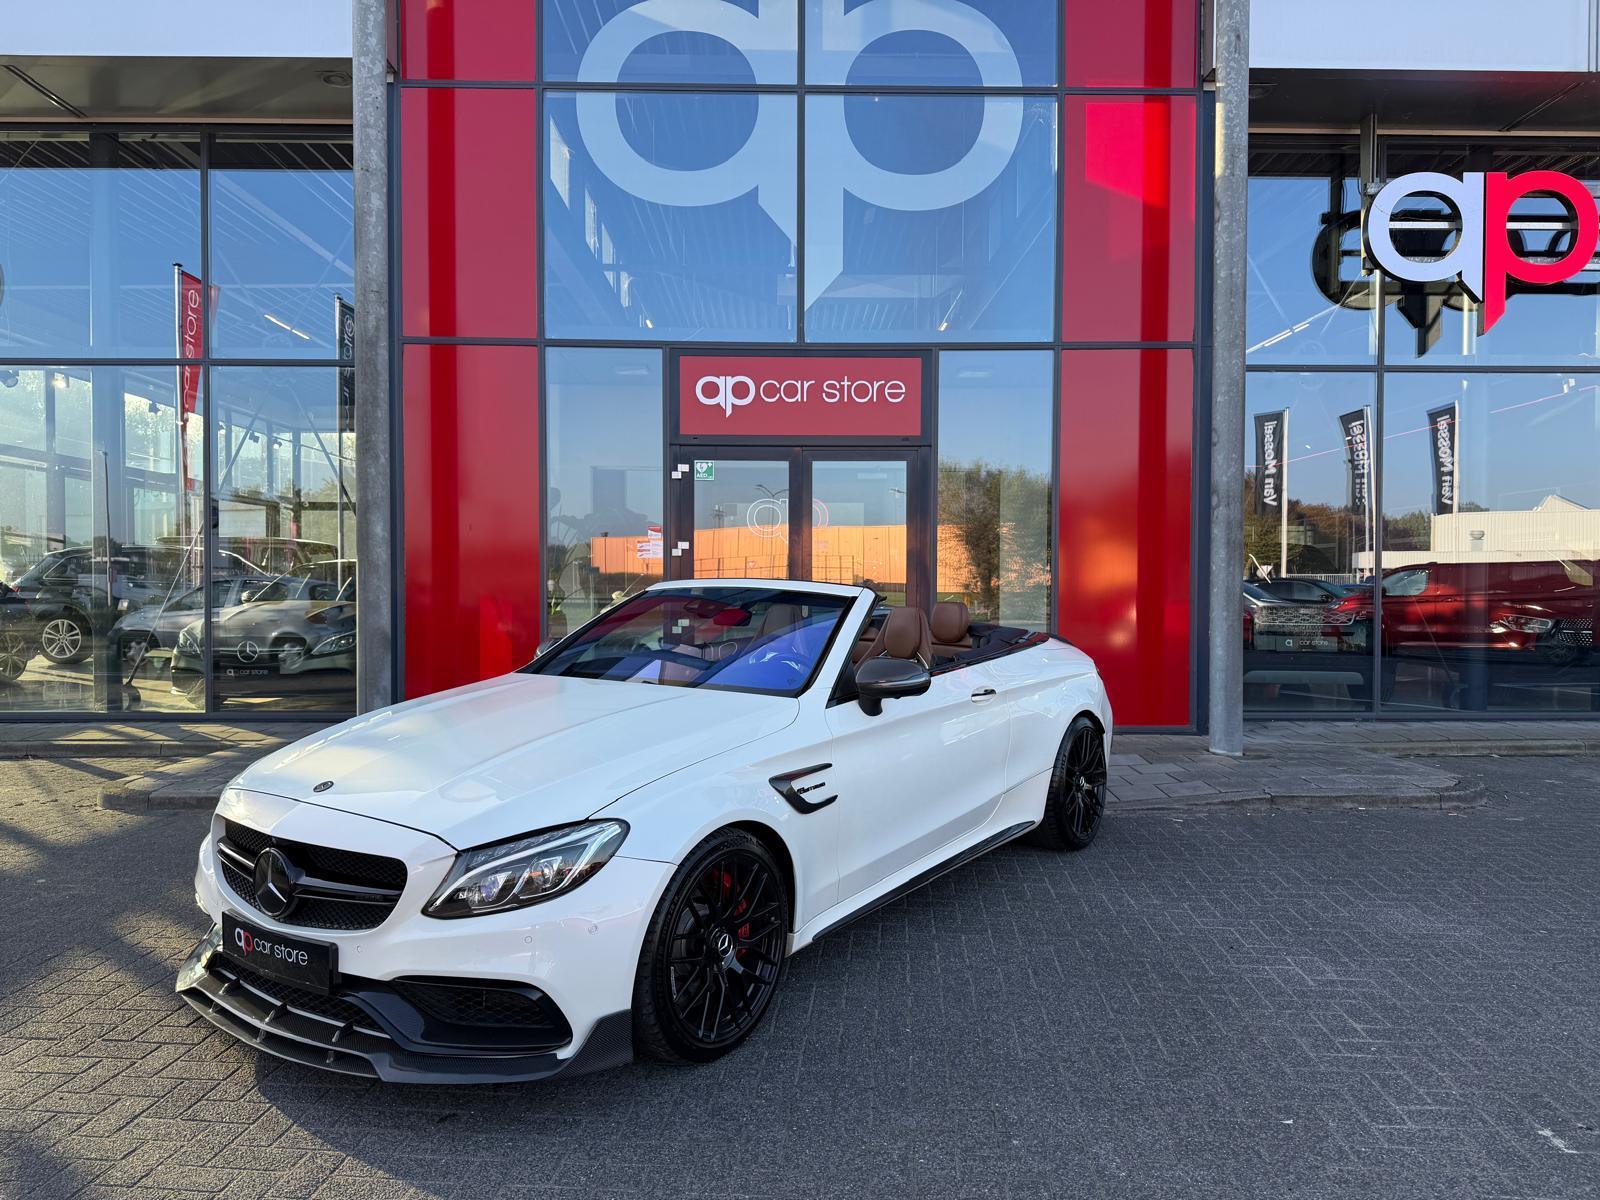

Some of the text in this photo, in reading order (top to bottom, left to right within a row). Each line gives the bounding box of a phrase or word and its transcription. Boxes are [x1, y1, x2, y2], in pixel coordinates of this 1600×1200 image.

[184, 289, 199, 359] store
[760, 379, 815, 403] car
[822, 375, 906, 403] store
[254, 938, 273, 955] car
[274, 944, 309, 966] store
